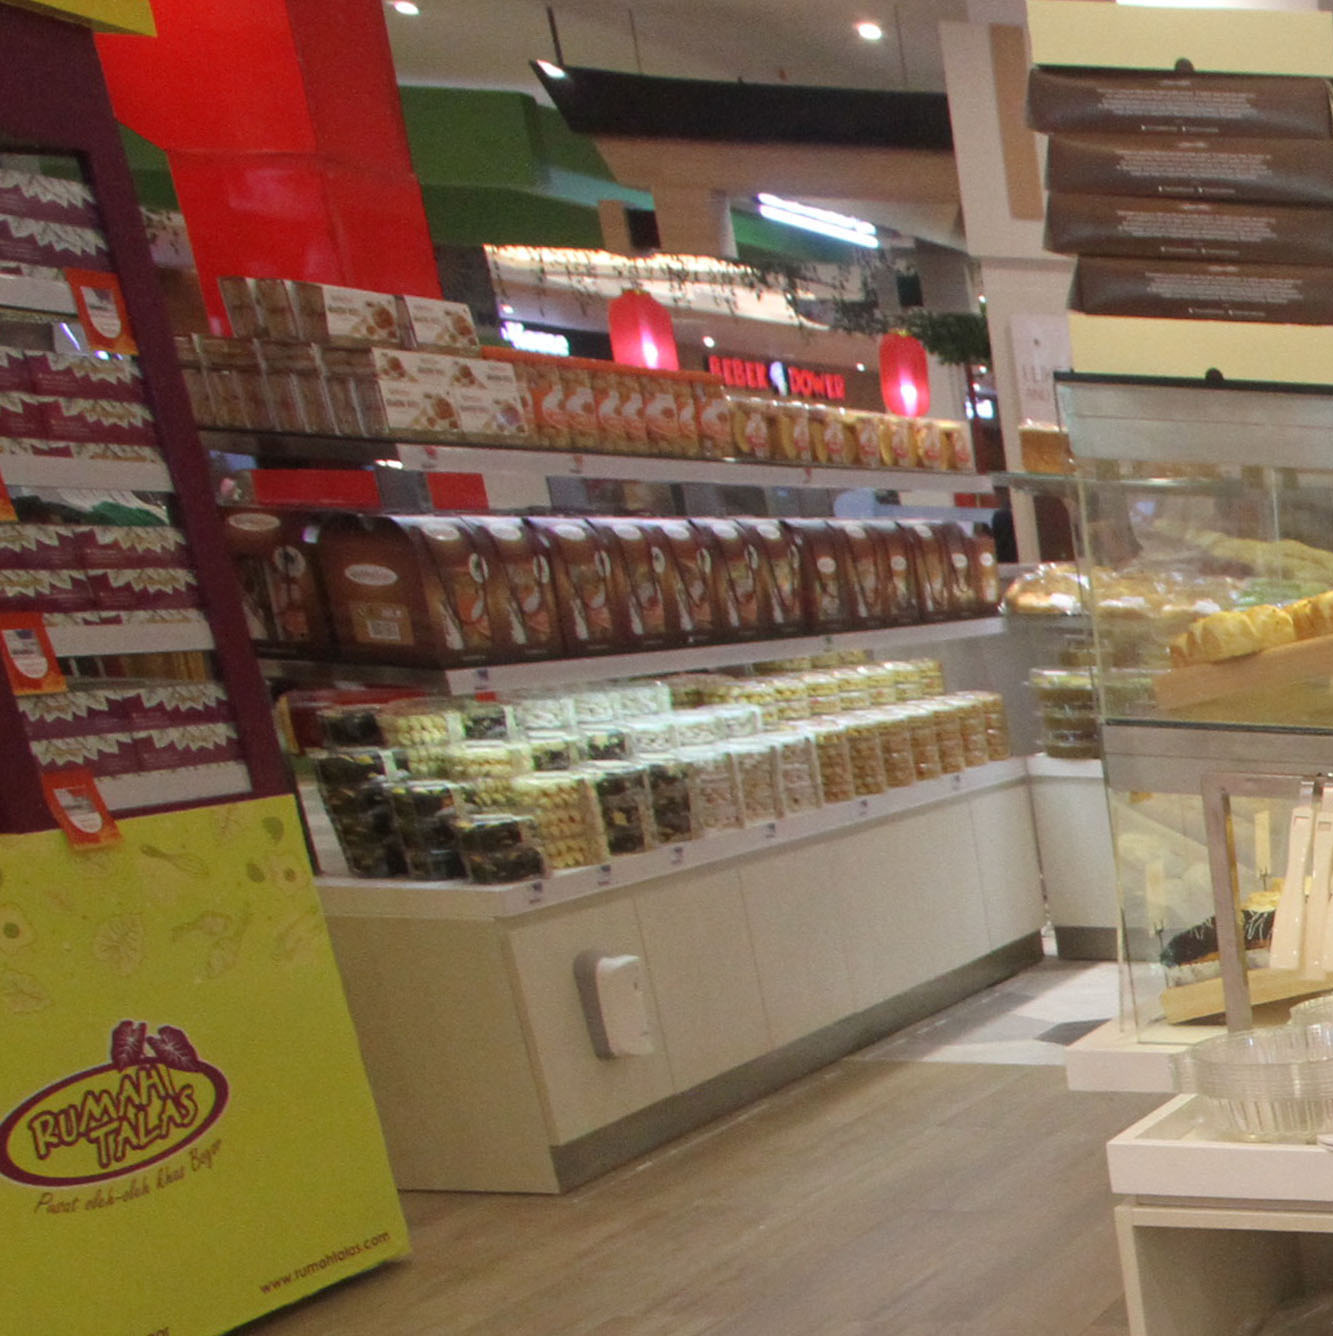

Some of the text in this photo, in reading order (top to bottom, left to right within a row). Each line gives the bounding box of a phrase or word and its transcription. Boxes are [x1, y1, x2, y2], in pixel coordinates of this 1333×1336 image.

[708, 354, 846, 400] BEBEK DOWER
[28, 1063, 176, 1160] RUMAH
[86, 1083, 198, 1169] TALAS
[189, 1138, 222, 1172] Bogor
[258, 1231, 392, 1294] www.rumahtalas.com
